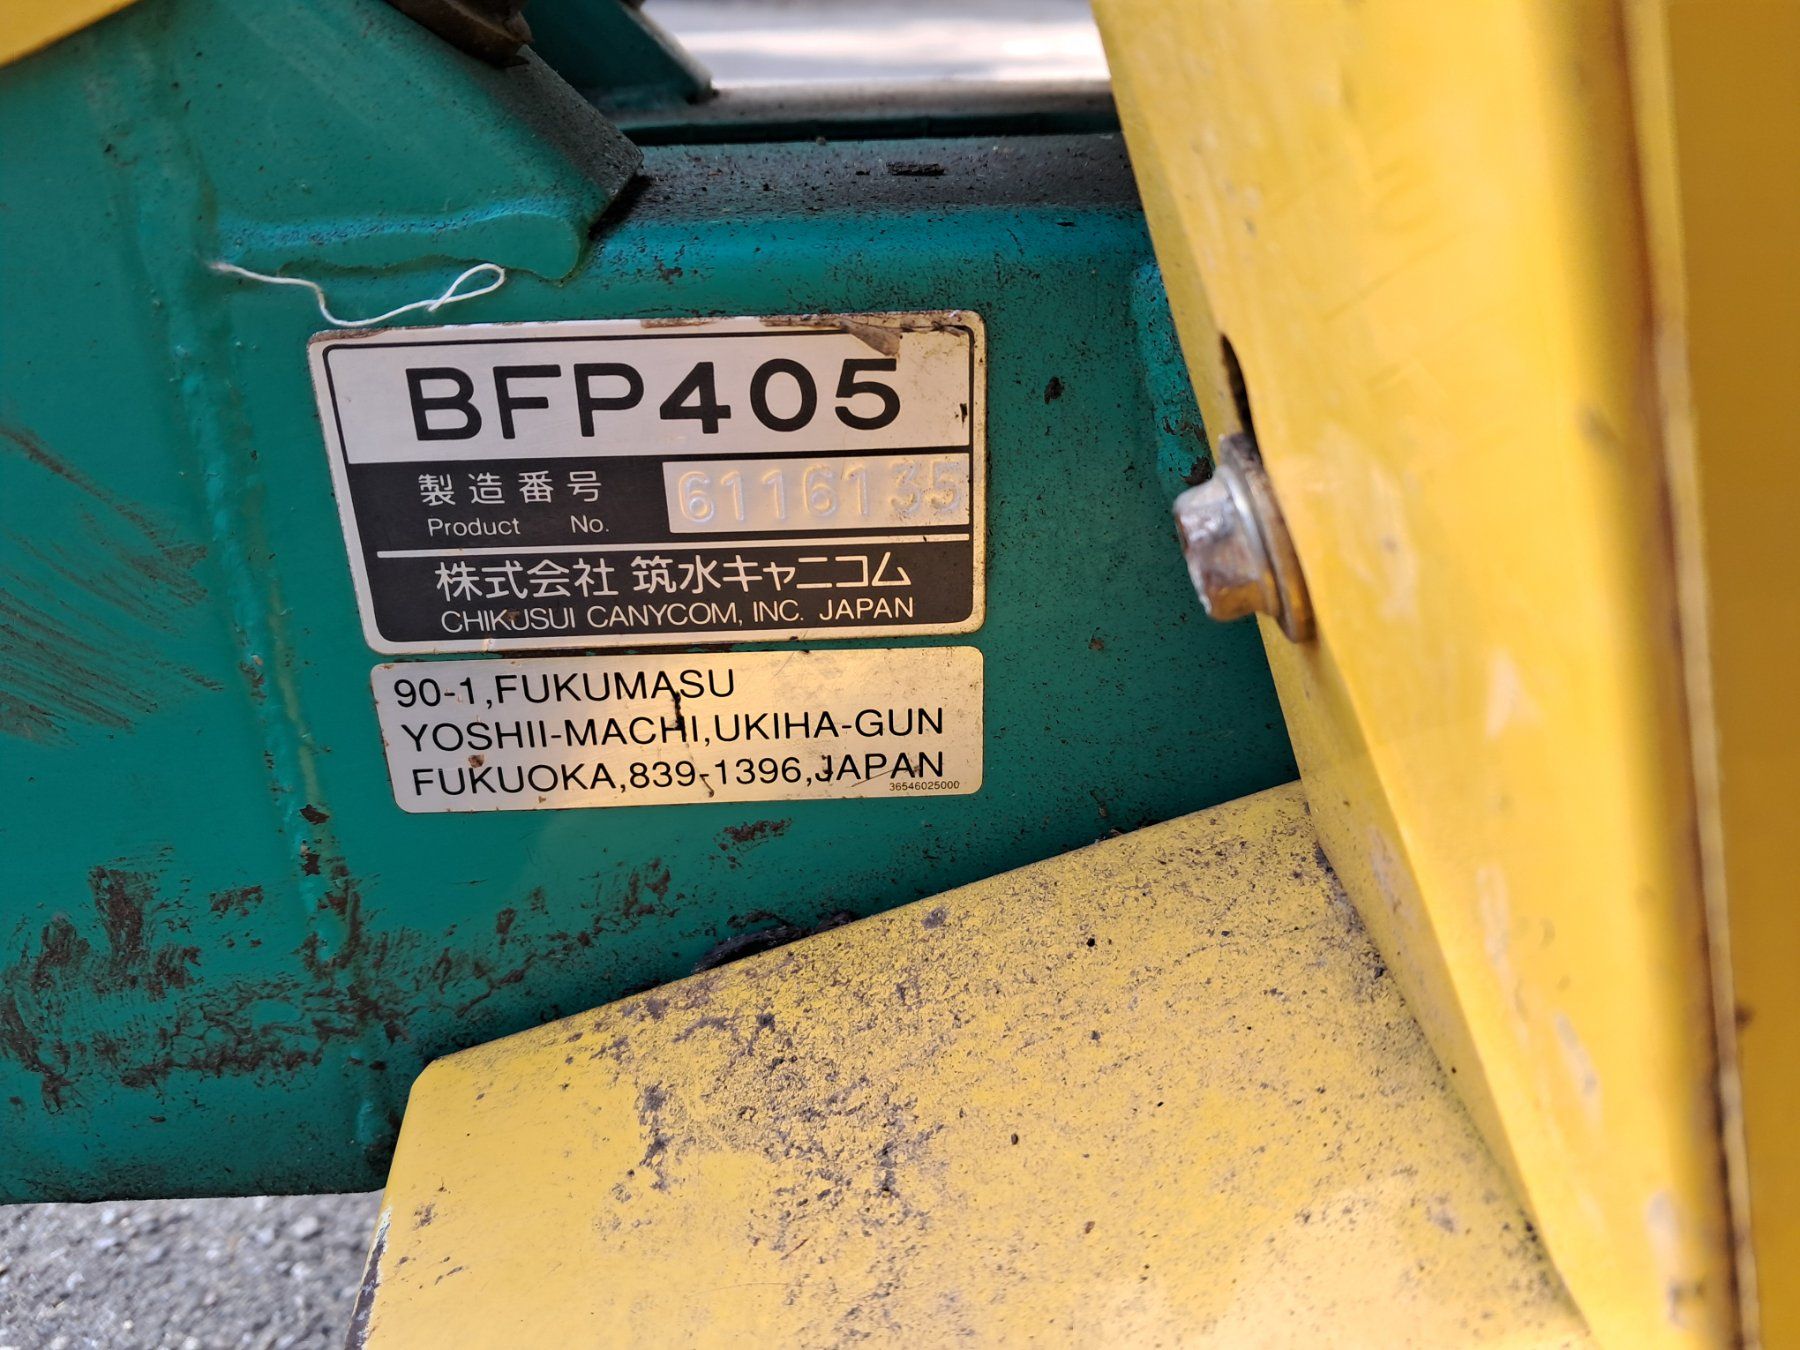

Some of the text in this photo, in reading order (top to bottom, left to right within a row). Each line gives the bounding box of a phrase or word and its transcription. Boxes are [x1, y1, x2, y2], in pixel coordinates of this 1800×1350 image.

[405, 358, 900, 441] BFP405
[418, 470, 601, 507] 製造番号
[678, 459, 962, 523] 6116135
[427, 514, 610, 537] Product No.
[434, 552, 912, 601] 株式会社 筑水キャニコム
[441, 597, 914, 633] CHIKUSUI CANYCOM, INC. JAPAN
[889, 780, 960, 792] 36546025000
